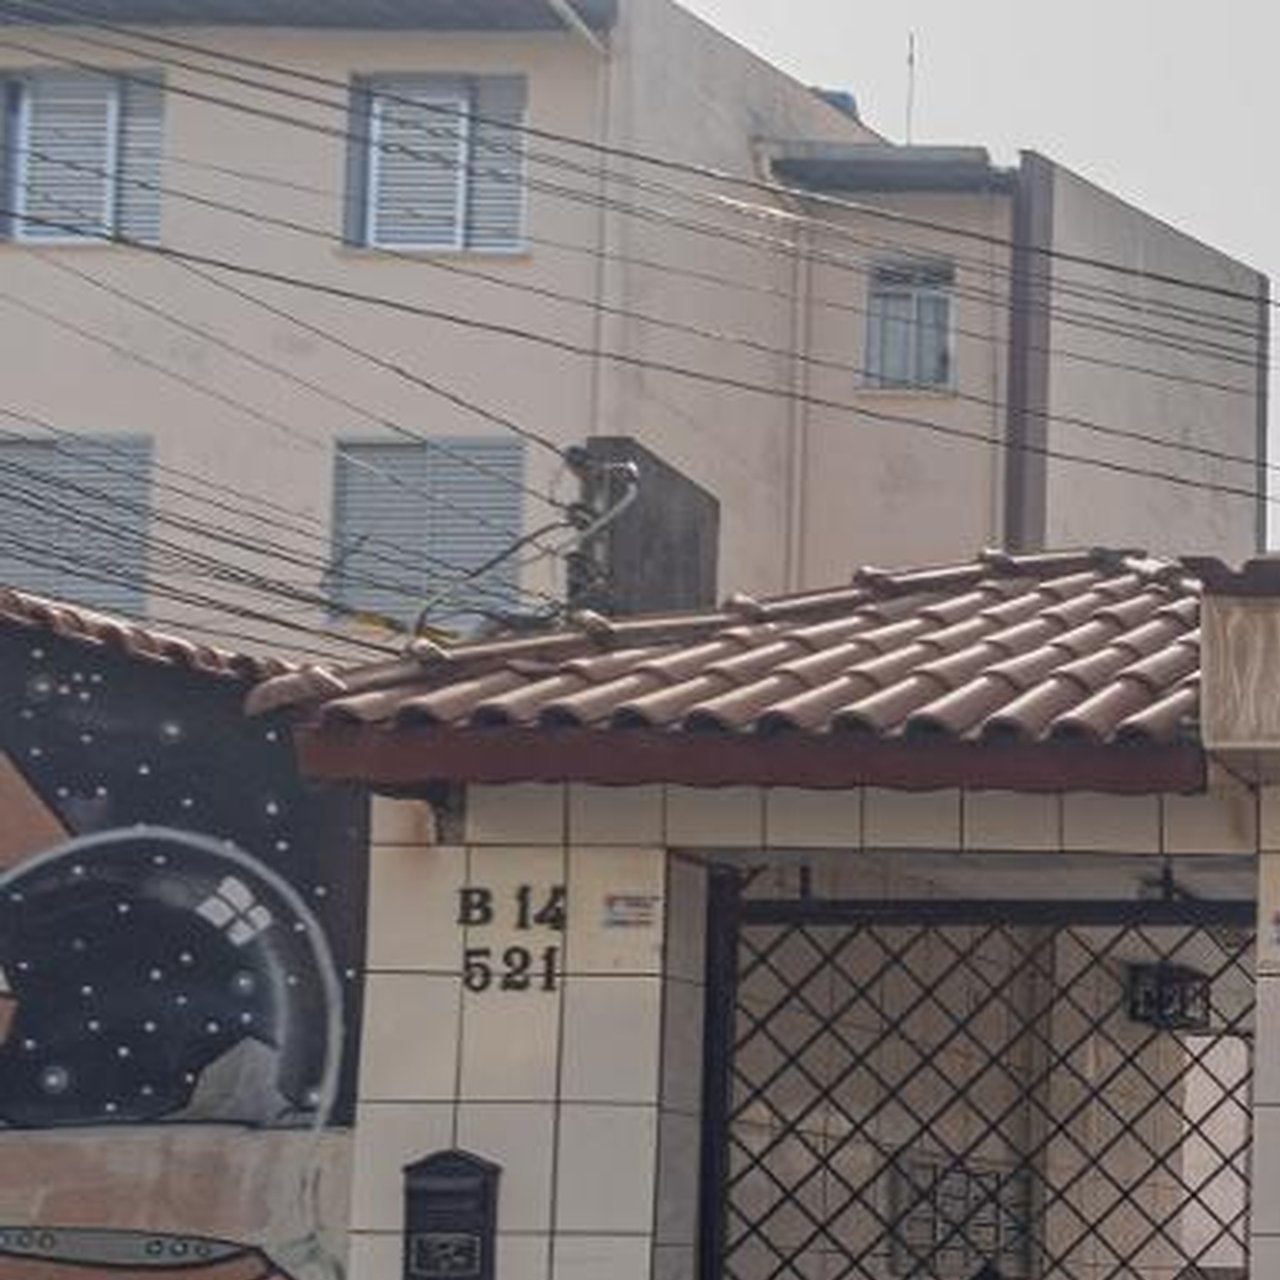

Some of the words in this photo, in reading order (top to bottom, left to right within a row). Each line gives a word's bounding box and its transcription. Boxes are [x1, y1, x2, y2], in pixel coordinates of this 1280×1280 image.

[457, 887, 493, 926] B
[514, 885, 568, 930] 14
[462, 946, 559, 992] 521
